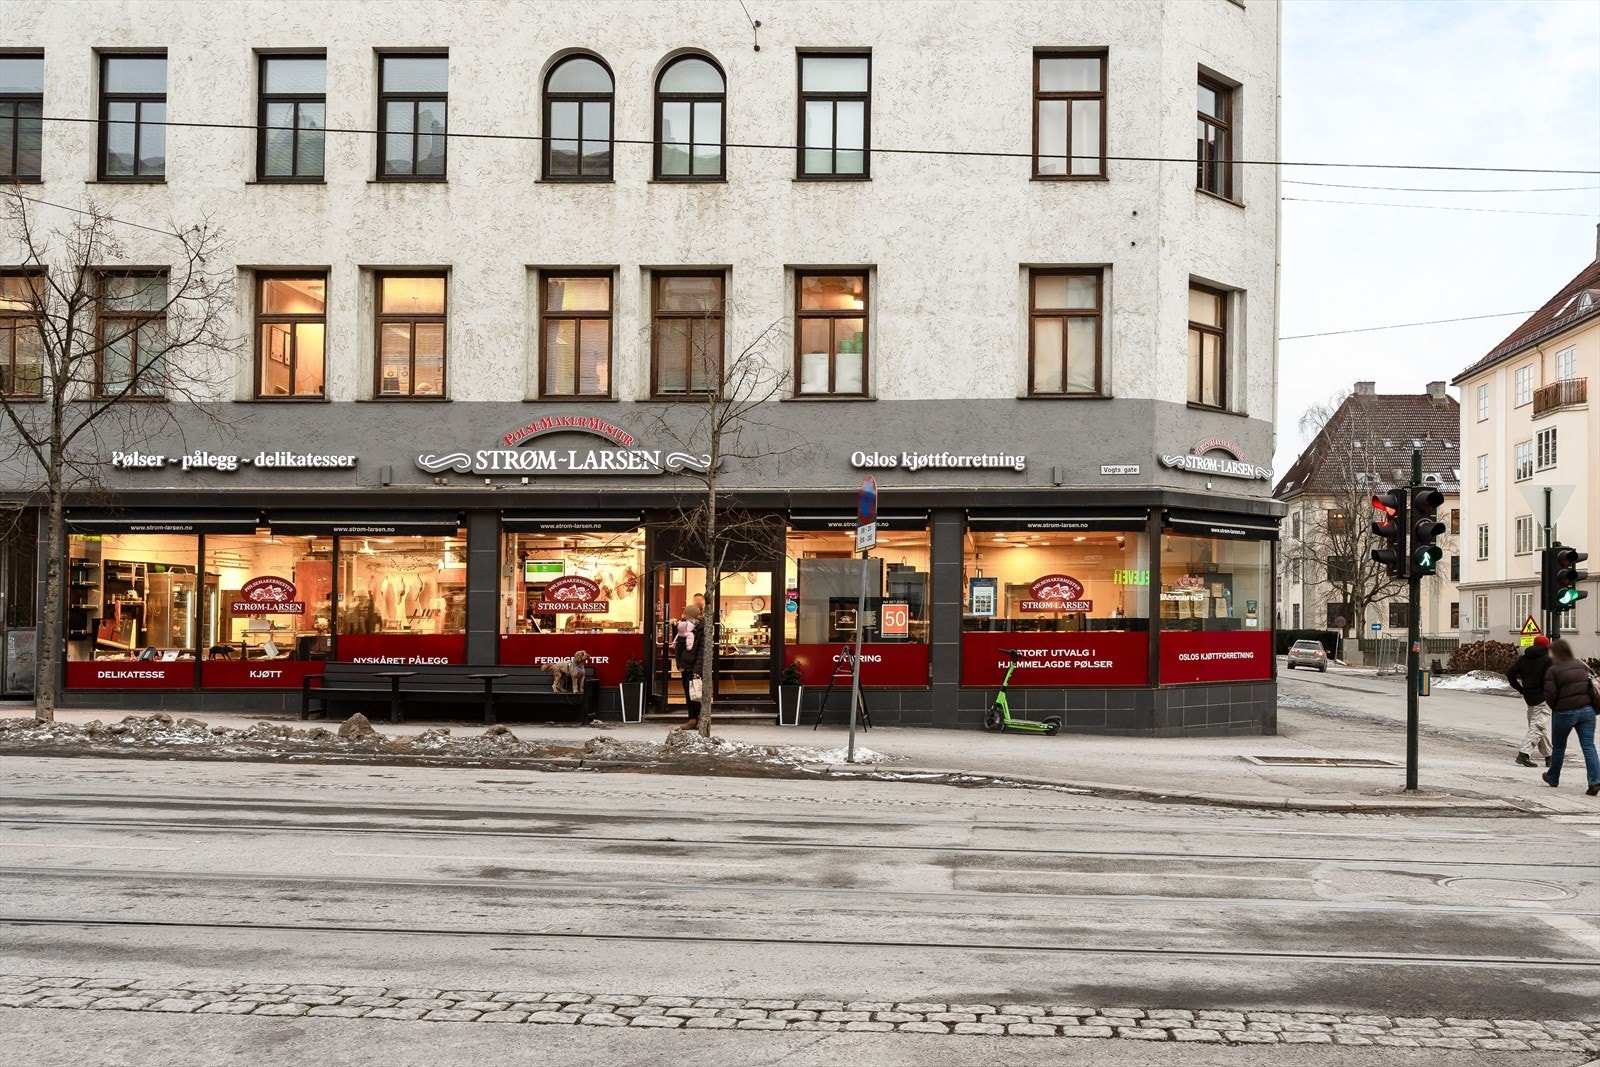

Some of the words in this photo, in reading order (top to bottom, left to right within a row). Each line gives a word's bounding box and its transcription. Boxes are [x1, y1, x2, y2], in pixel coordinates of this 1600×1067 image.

[112, 451, 164, 468] Pølser
[182, 450, 238, 470] pålegg
[254, 452, 356, 467] delikatesser
[851, 452, 898, 467] Oslos
[902, 452, 1026, 471] kjøttforretning
[234, 603, 302, 611] STRØM-LARSEN
[538, 602, 606, 610] STRØM-LARSEN
[884, 610, 906, 627] 50
[354, 655, 406, 664] NYSKÅRET
[408, 655, 448, 664] PÅLEGG
[1200, 652, 1254, 660] KJØTTFORRETNING
[1074, 660, 1113, 668] PØLSER
[250, 670, 282, 678] KJØTT
